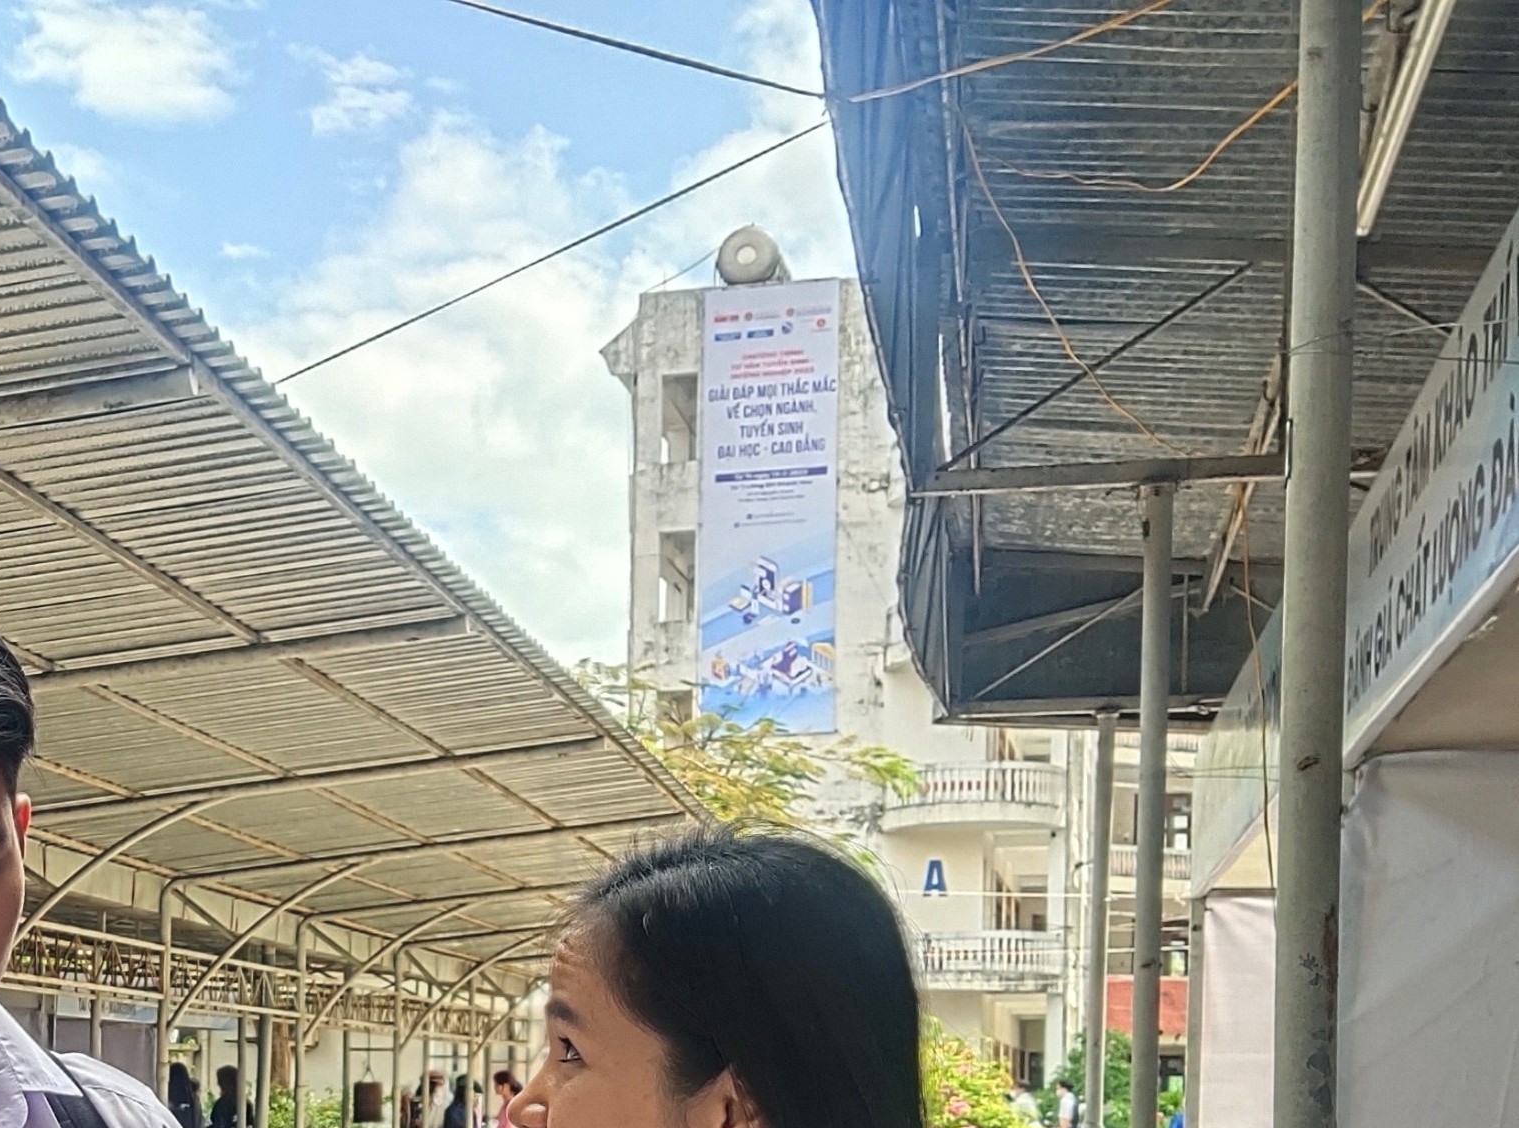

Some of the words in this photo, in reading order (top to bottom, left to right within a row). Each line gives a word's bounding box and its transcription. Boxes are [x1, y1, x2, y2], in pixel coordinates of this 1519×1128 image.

[732, 383, 754, 400] ĐÁP
[757, 384, 777, 399] MỌI
[743, 402, 772, 418] CHỌN
[777, 421, 803, 436] SINH
[717, 444, 736, 460] ĐẠI
[739, 442, 760, 458] HỌC
[771, 440, 792, 454] CAO
[1369, 466, 1402, 577] TRUNG
[1405, 411, 1430, 516] TÂM
[922, 859, 948, 897] A
